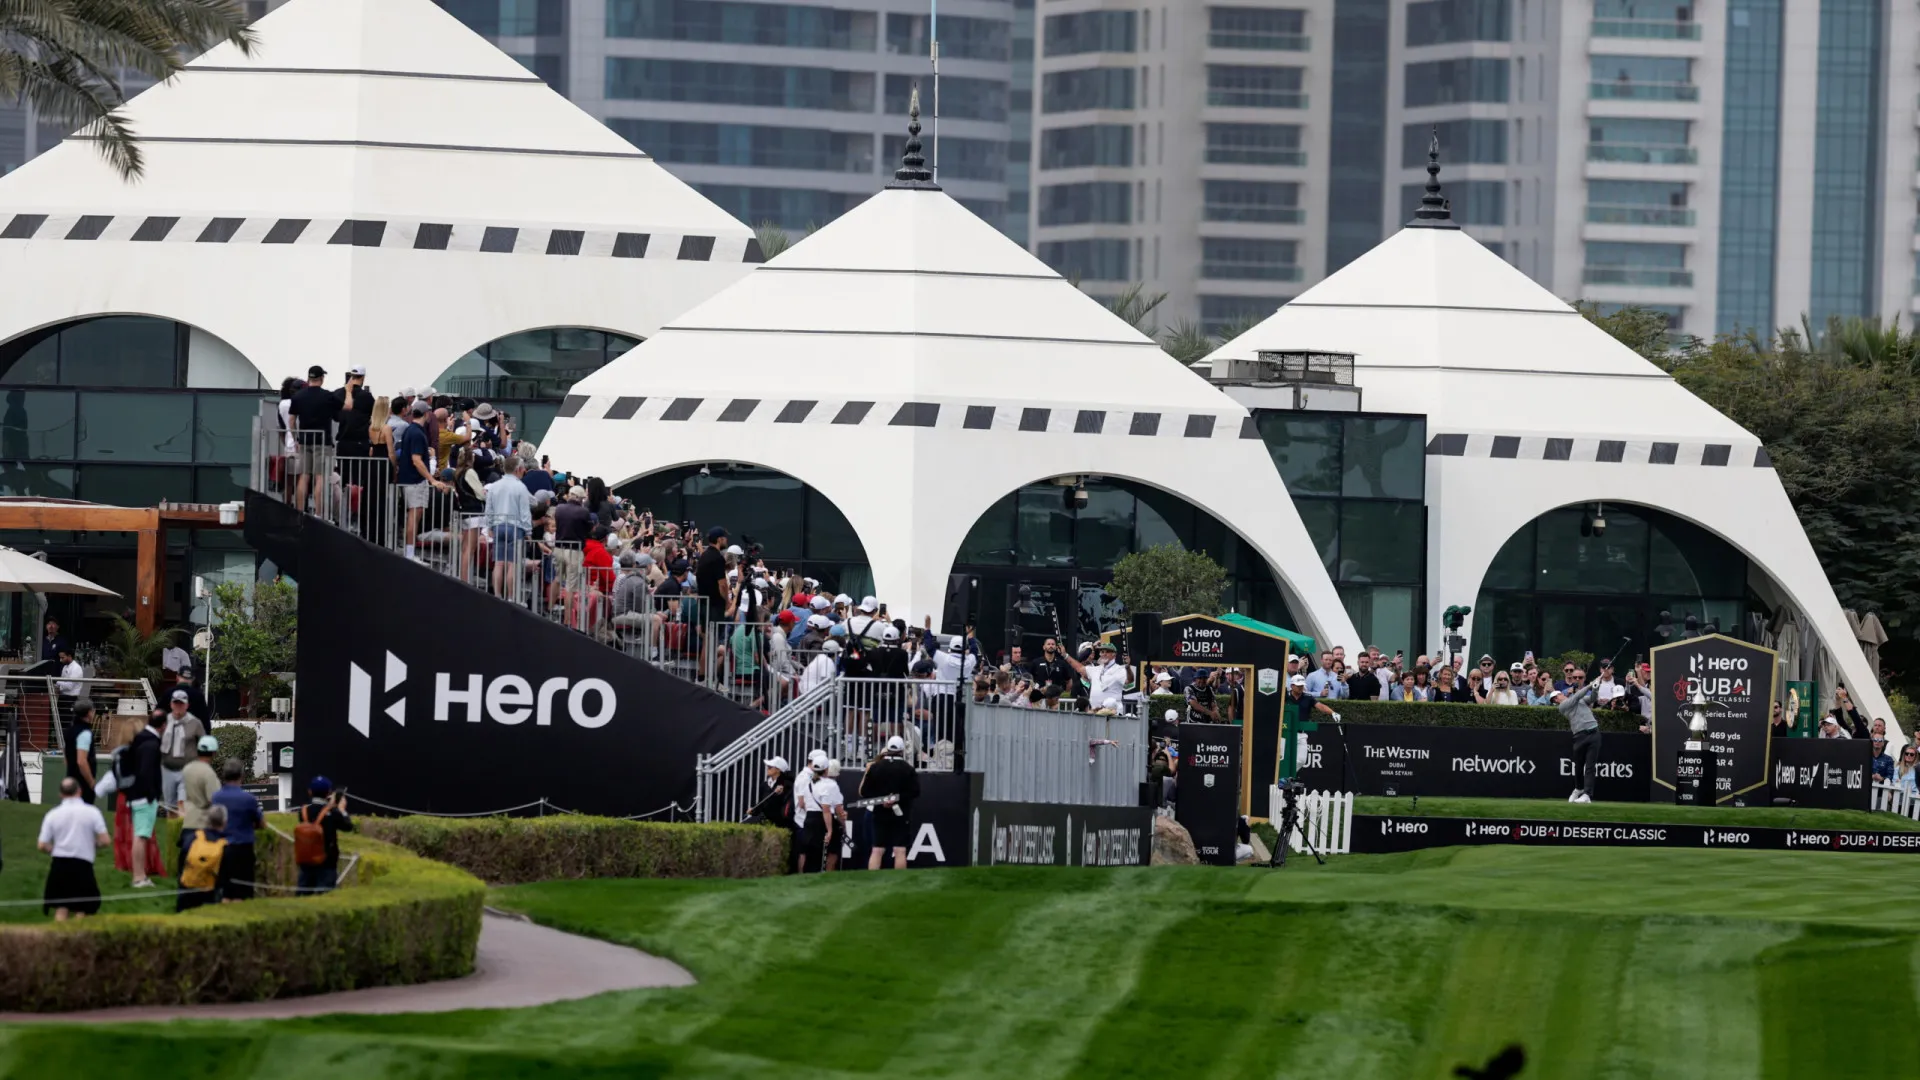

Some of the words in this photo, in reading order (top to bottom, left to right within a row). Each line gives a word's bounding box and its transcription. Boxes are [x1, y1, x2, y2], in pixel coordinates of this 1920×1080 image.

[1195, 629, 1221, 638] Hero
[1181, 641, 1223, 653] DUBAI
[1708, 657, 1748, 671] Hero
[1687, 677, 1751, 696] DUBAI
[434, 672, 617, 728] Hero
[1710, 732, 1726, 740] 469
[1727, 732, 1741, 742] yds
[1307, 744, 1323, 752] RLD
[1363, 746, 1385, 758] THE
[1386, 746, 1430, 759] WESTIN
[1710, 745, 1725, 753] 429
[1195, 754, 1229, 764] DUBAI
[1303, 753, 1323, 768] UR
[1452, 755, 1527, 773] network
[1727, 759, 1733, 767] 4
[1560, 758, 1633, 777] Erates
[1781, 765, 1796, 784] Hero
[1396, 822, 1428, 834] Hero
[1480, 825, 1510, 836] Hero
[1520, 825, 1559, 837] DUBAI
[1563, 827, 1612, 839] DESERT
[1613, 828, 1667, 840] CLASSIC
[1718, 832, 1750, 843] Hero
[1800, 834, 1830, 845] Hero
[1840, 834, 1879, 847] DUBAI
